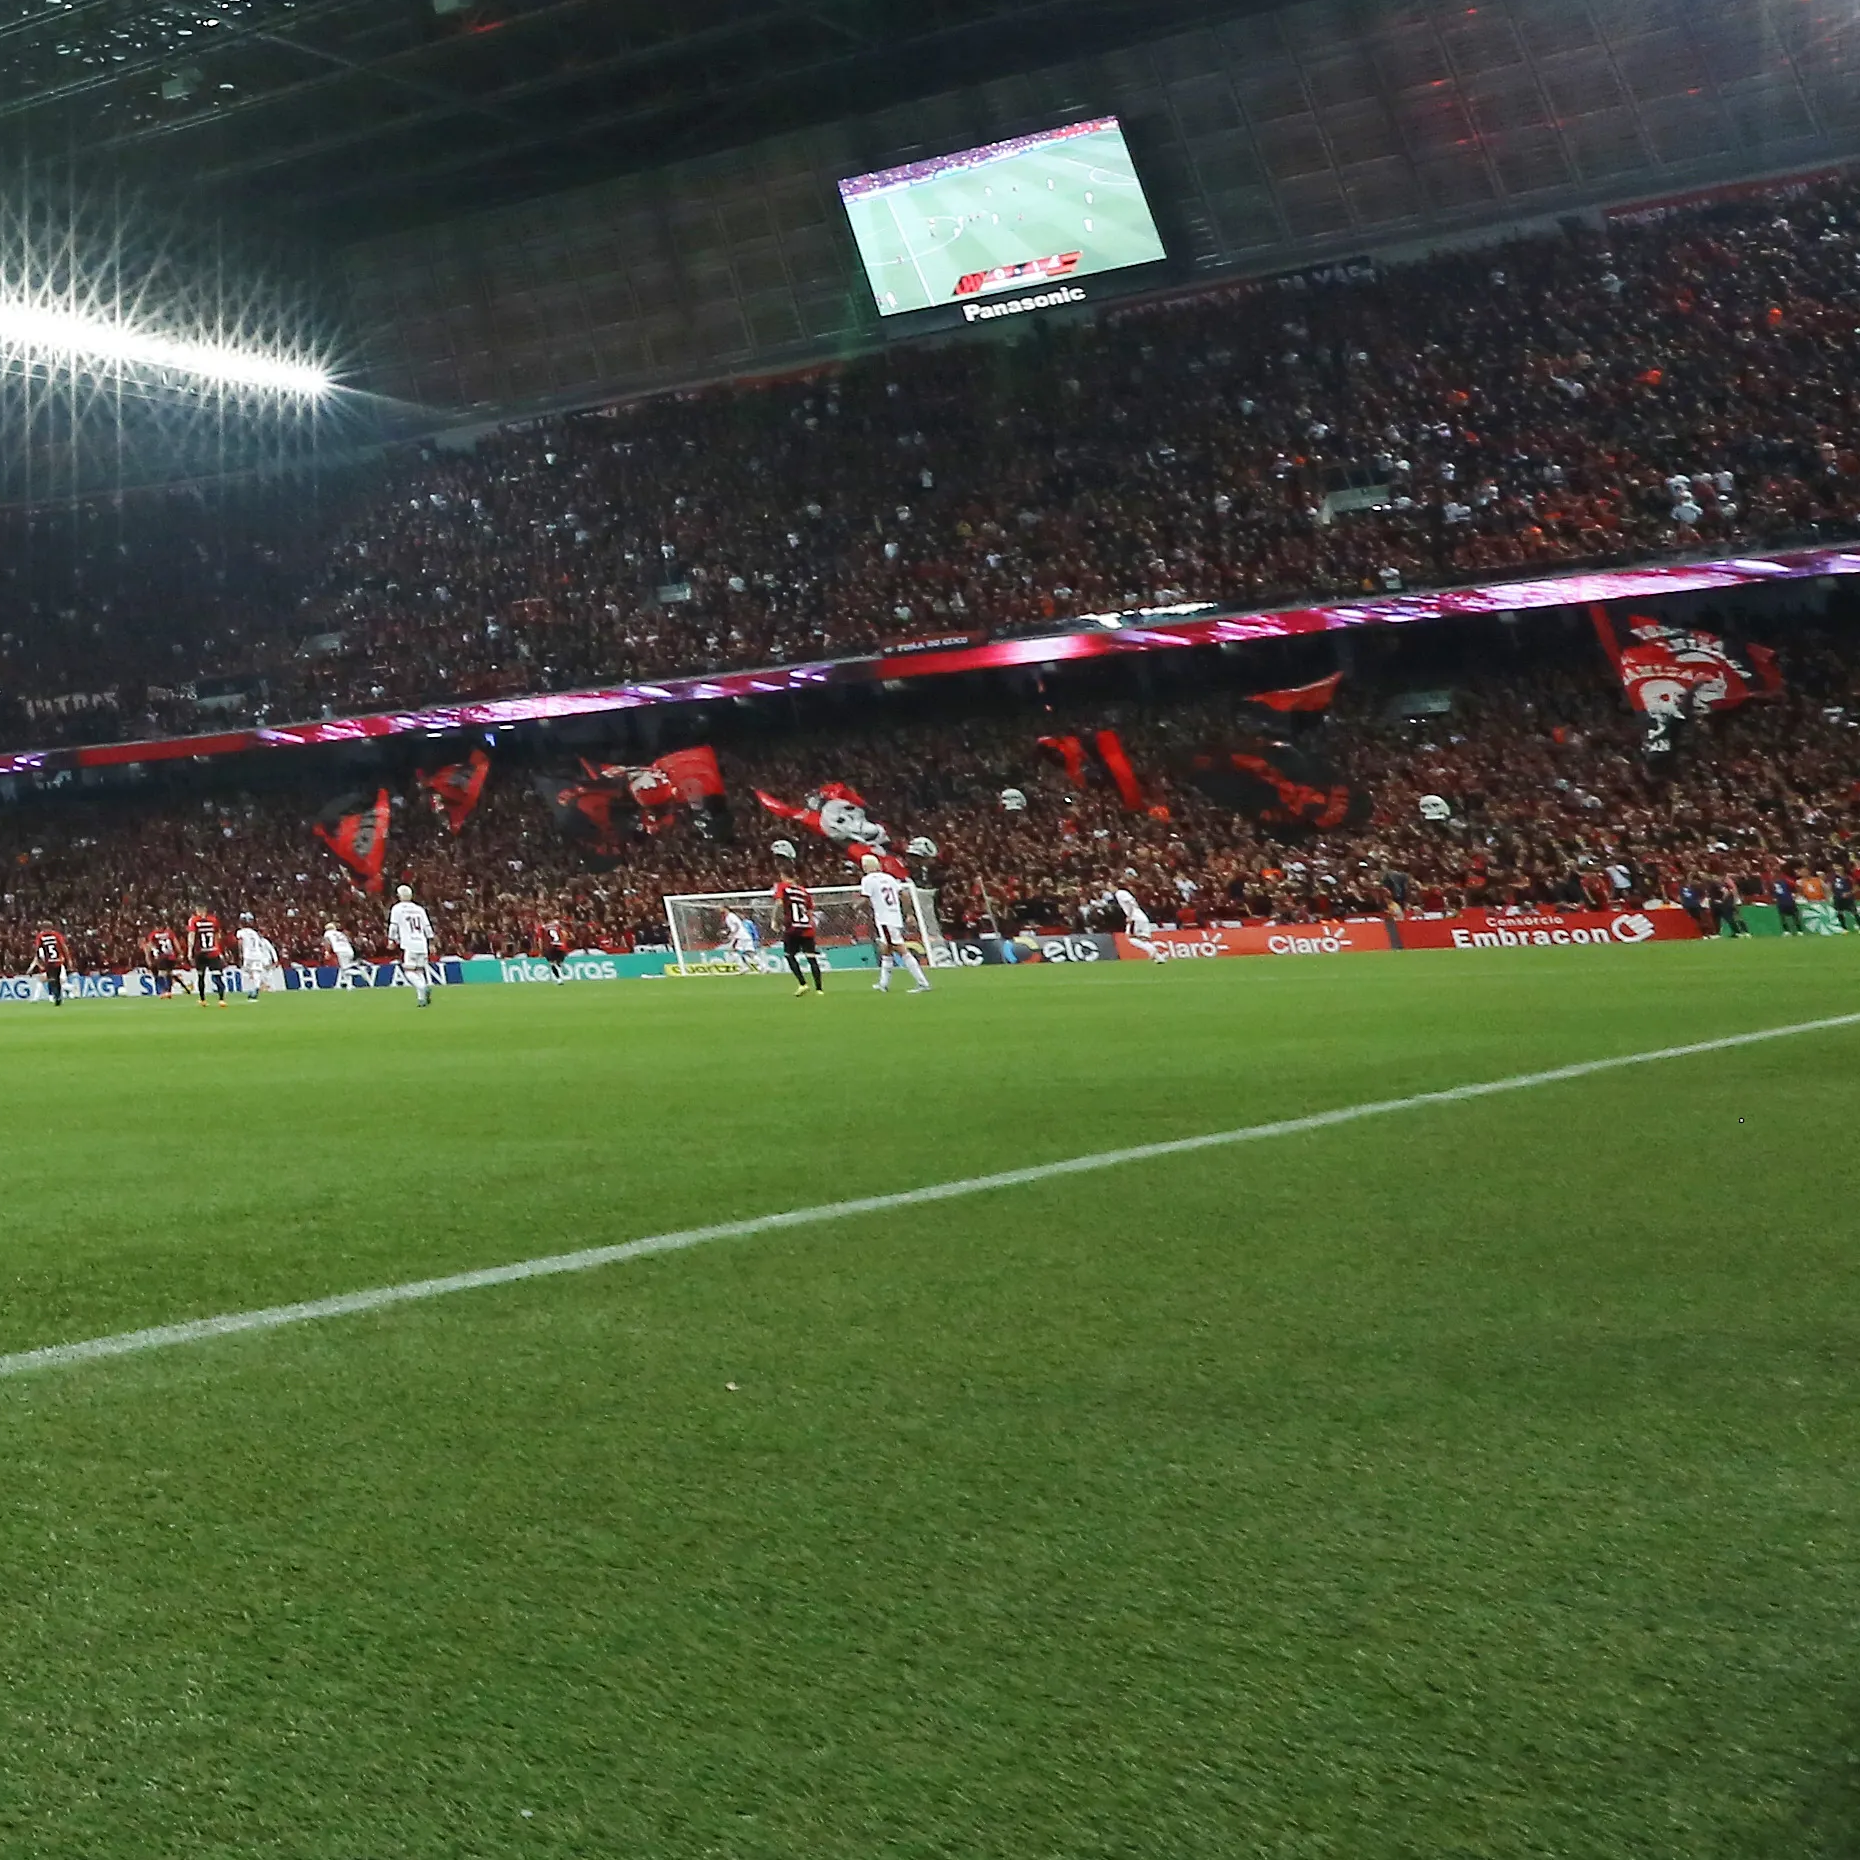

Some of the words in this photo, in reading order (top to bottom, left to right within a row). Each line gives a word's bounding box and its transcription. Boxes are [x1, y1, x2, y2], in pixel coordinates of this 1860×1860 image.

[962, 286, 1086, 322] Panasonic
[1268, 934, 1340, 955] Claro
[1450, 926, 1610, 949] Embracon
[48, 944, 58, 959] 5
[1042, 936, 1099, 963] elo
